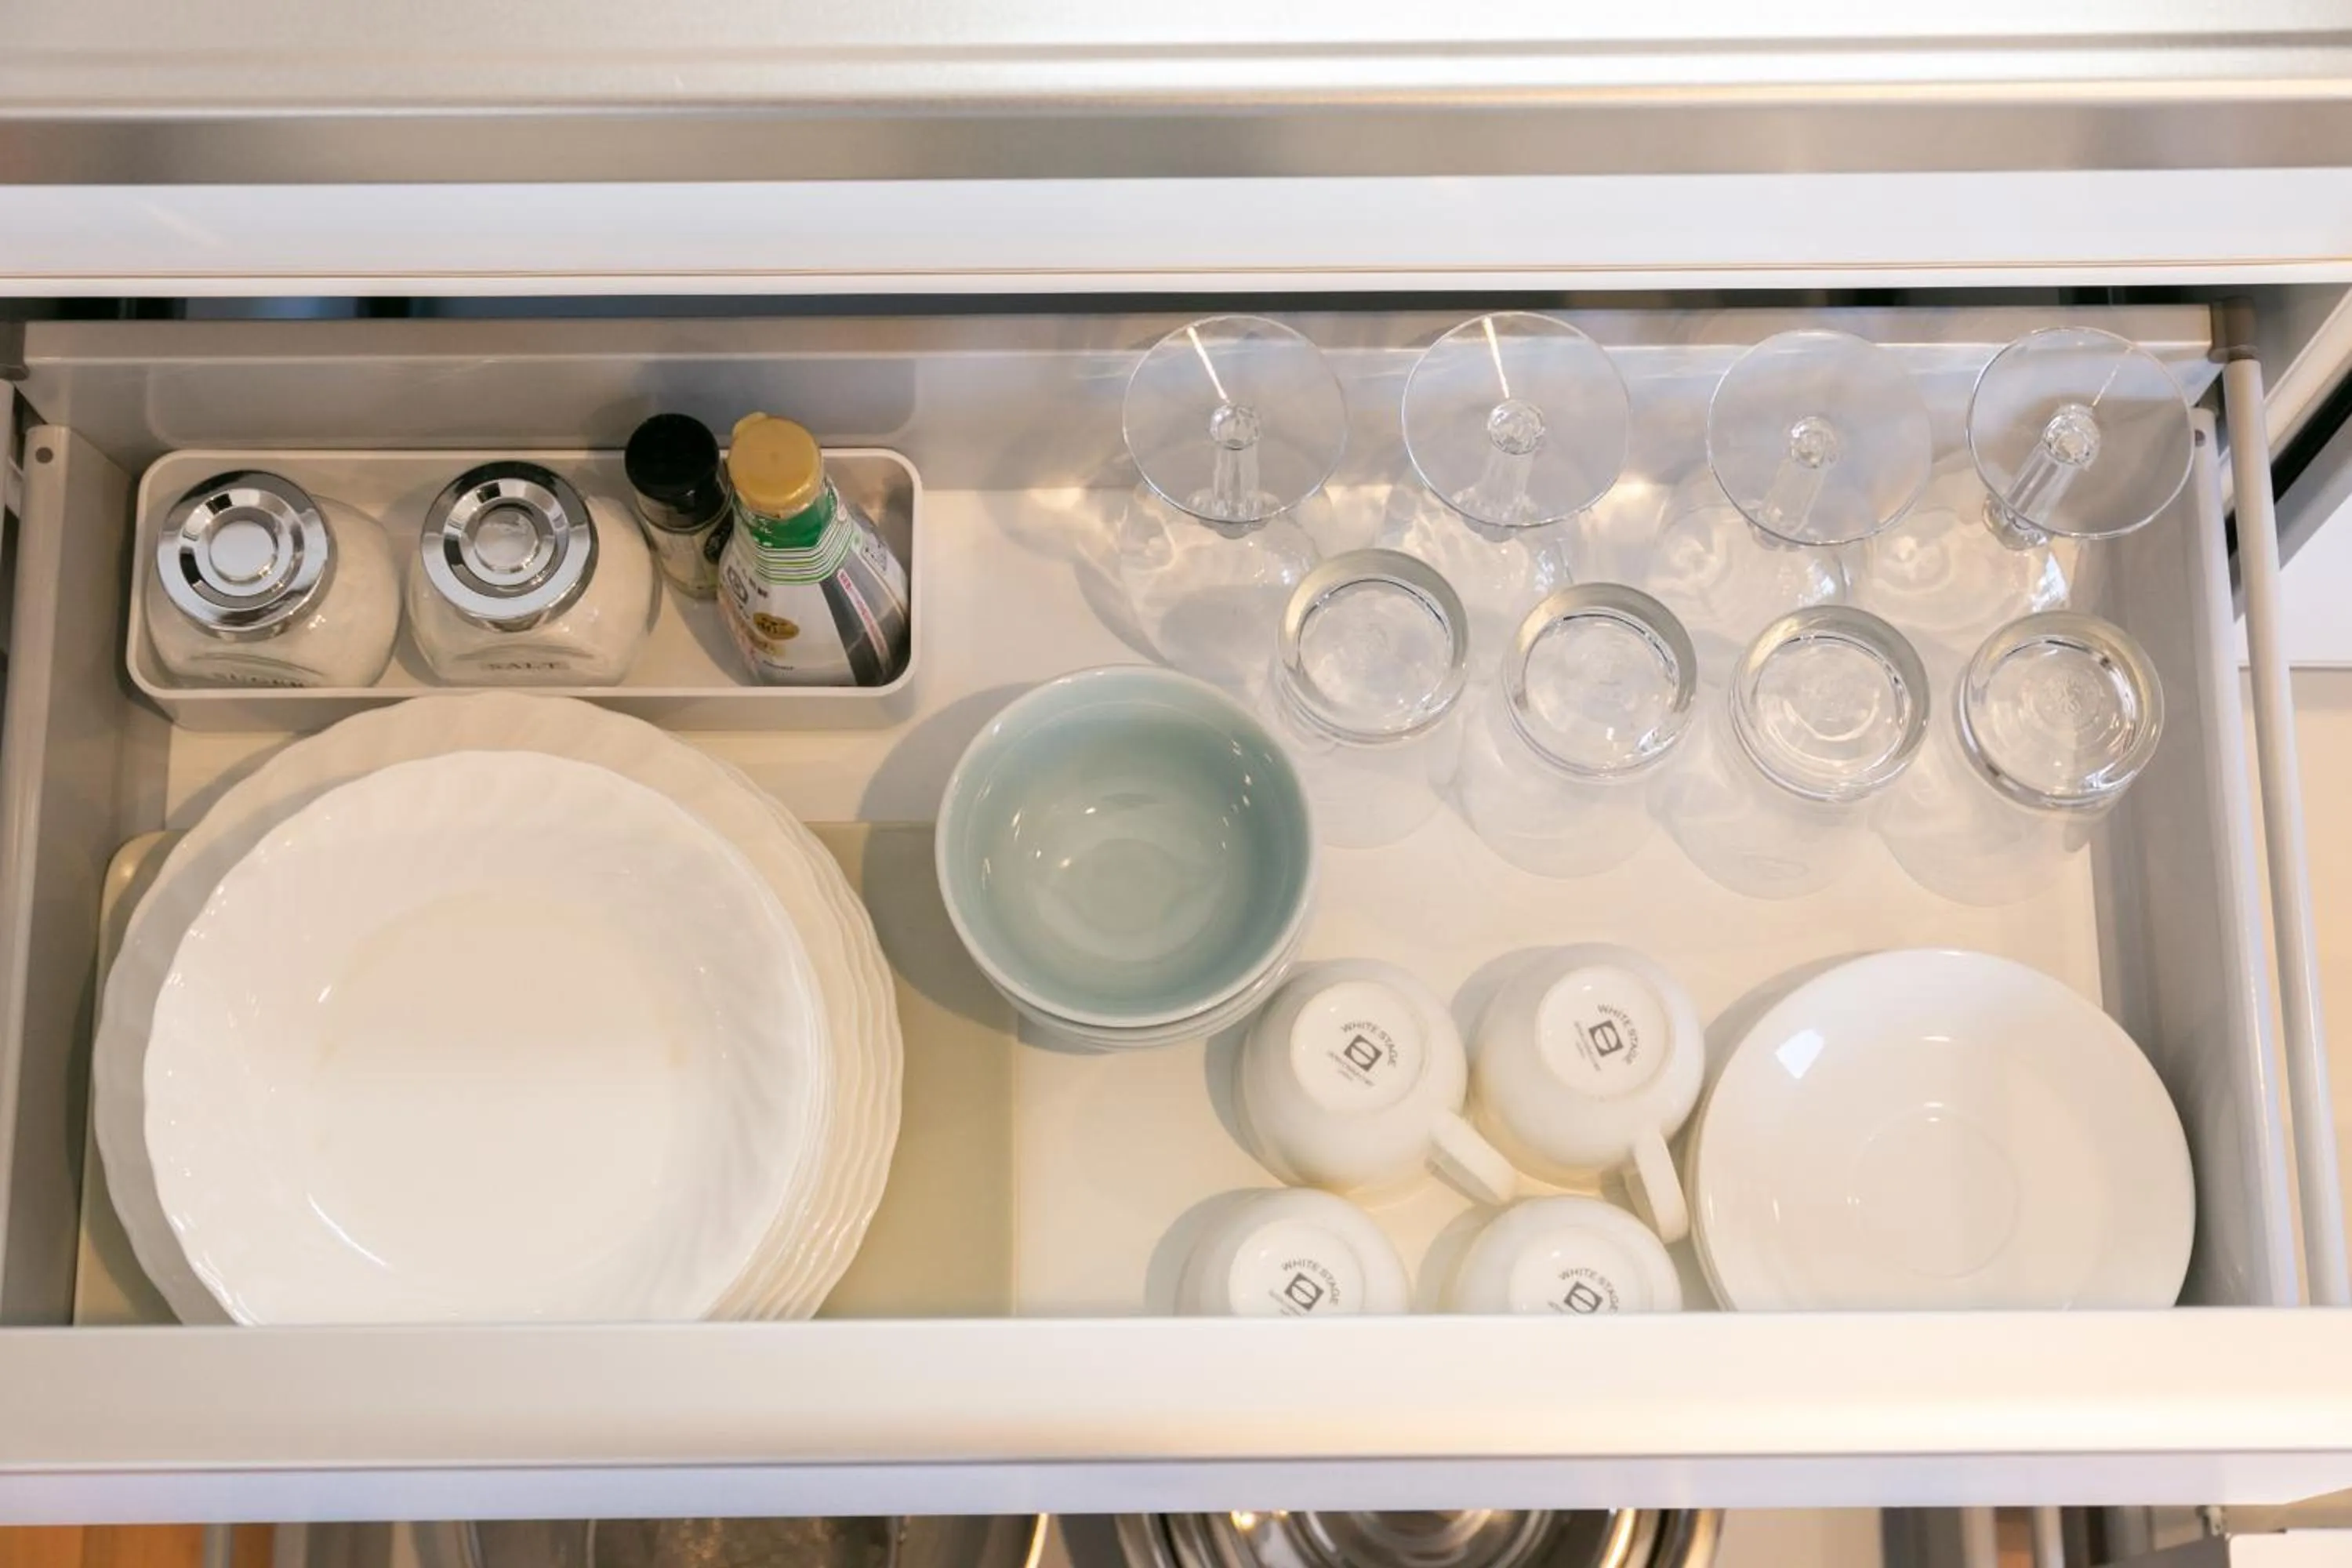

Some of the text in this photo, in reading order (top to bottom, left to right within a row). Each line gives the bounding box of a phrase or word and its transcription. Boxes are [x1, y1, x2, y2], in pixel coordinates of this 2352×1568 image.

[1341, 1021, 1399, 1069] WHITE STAGE
[1597, 1004, 1639, 1065] WHITE STAGE
[1280, 1258, 1319, 1272] WHITE
[1319, 1269, 1341, 1306] STAGE
[1558, 1267, 1621, 1316] WHITE STAGE
